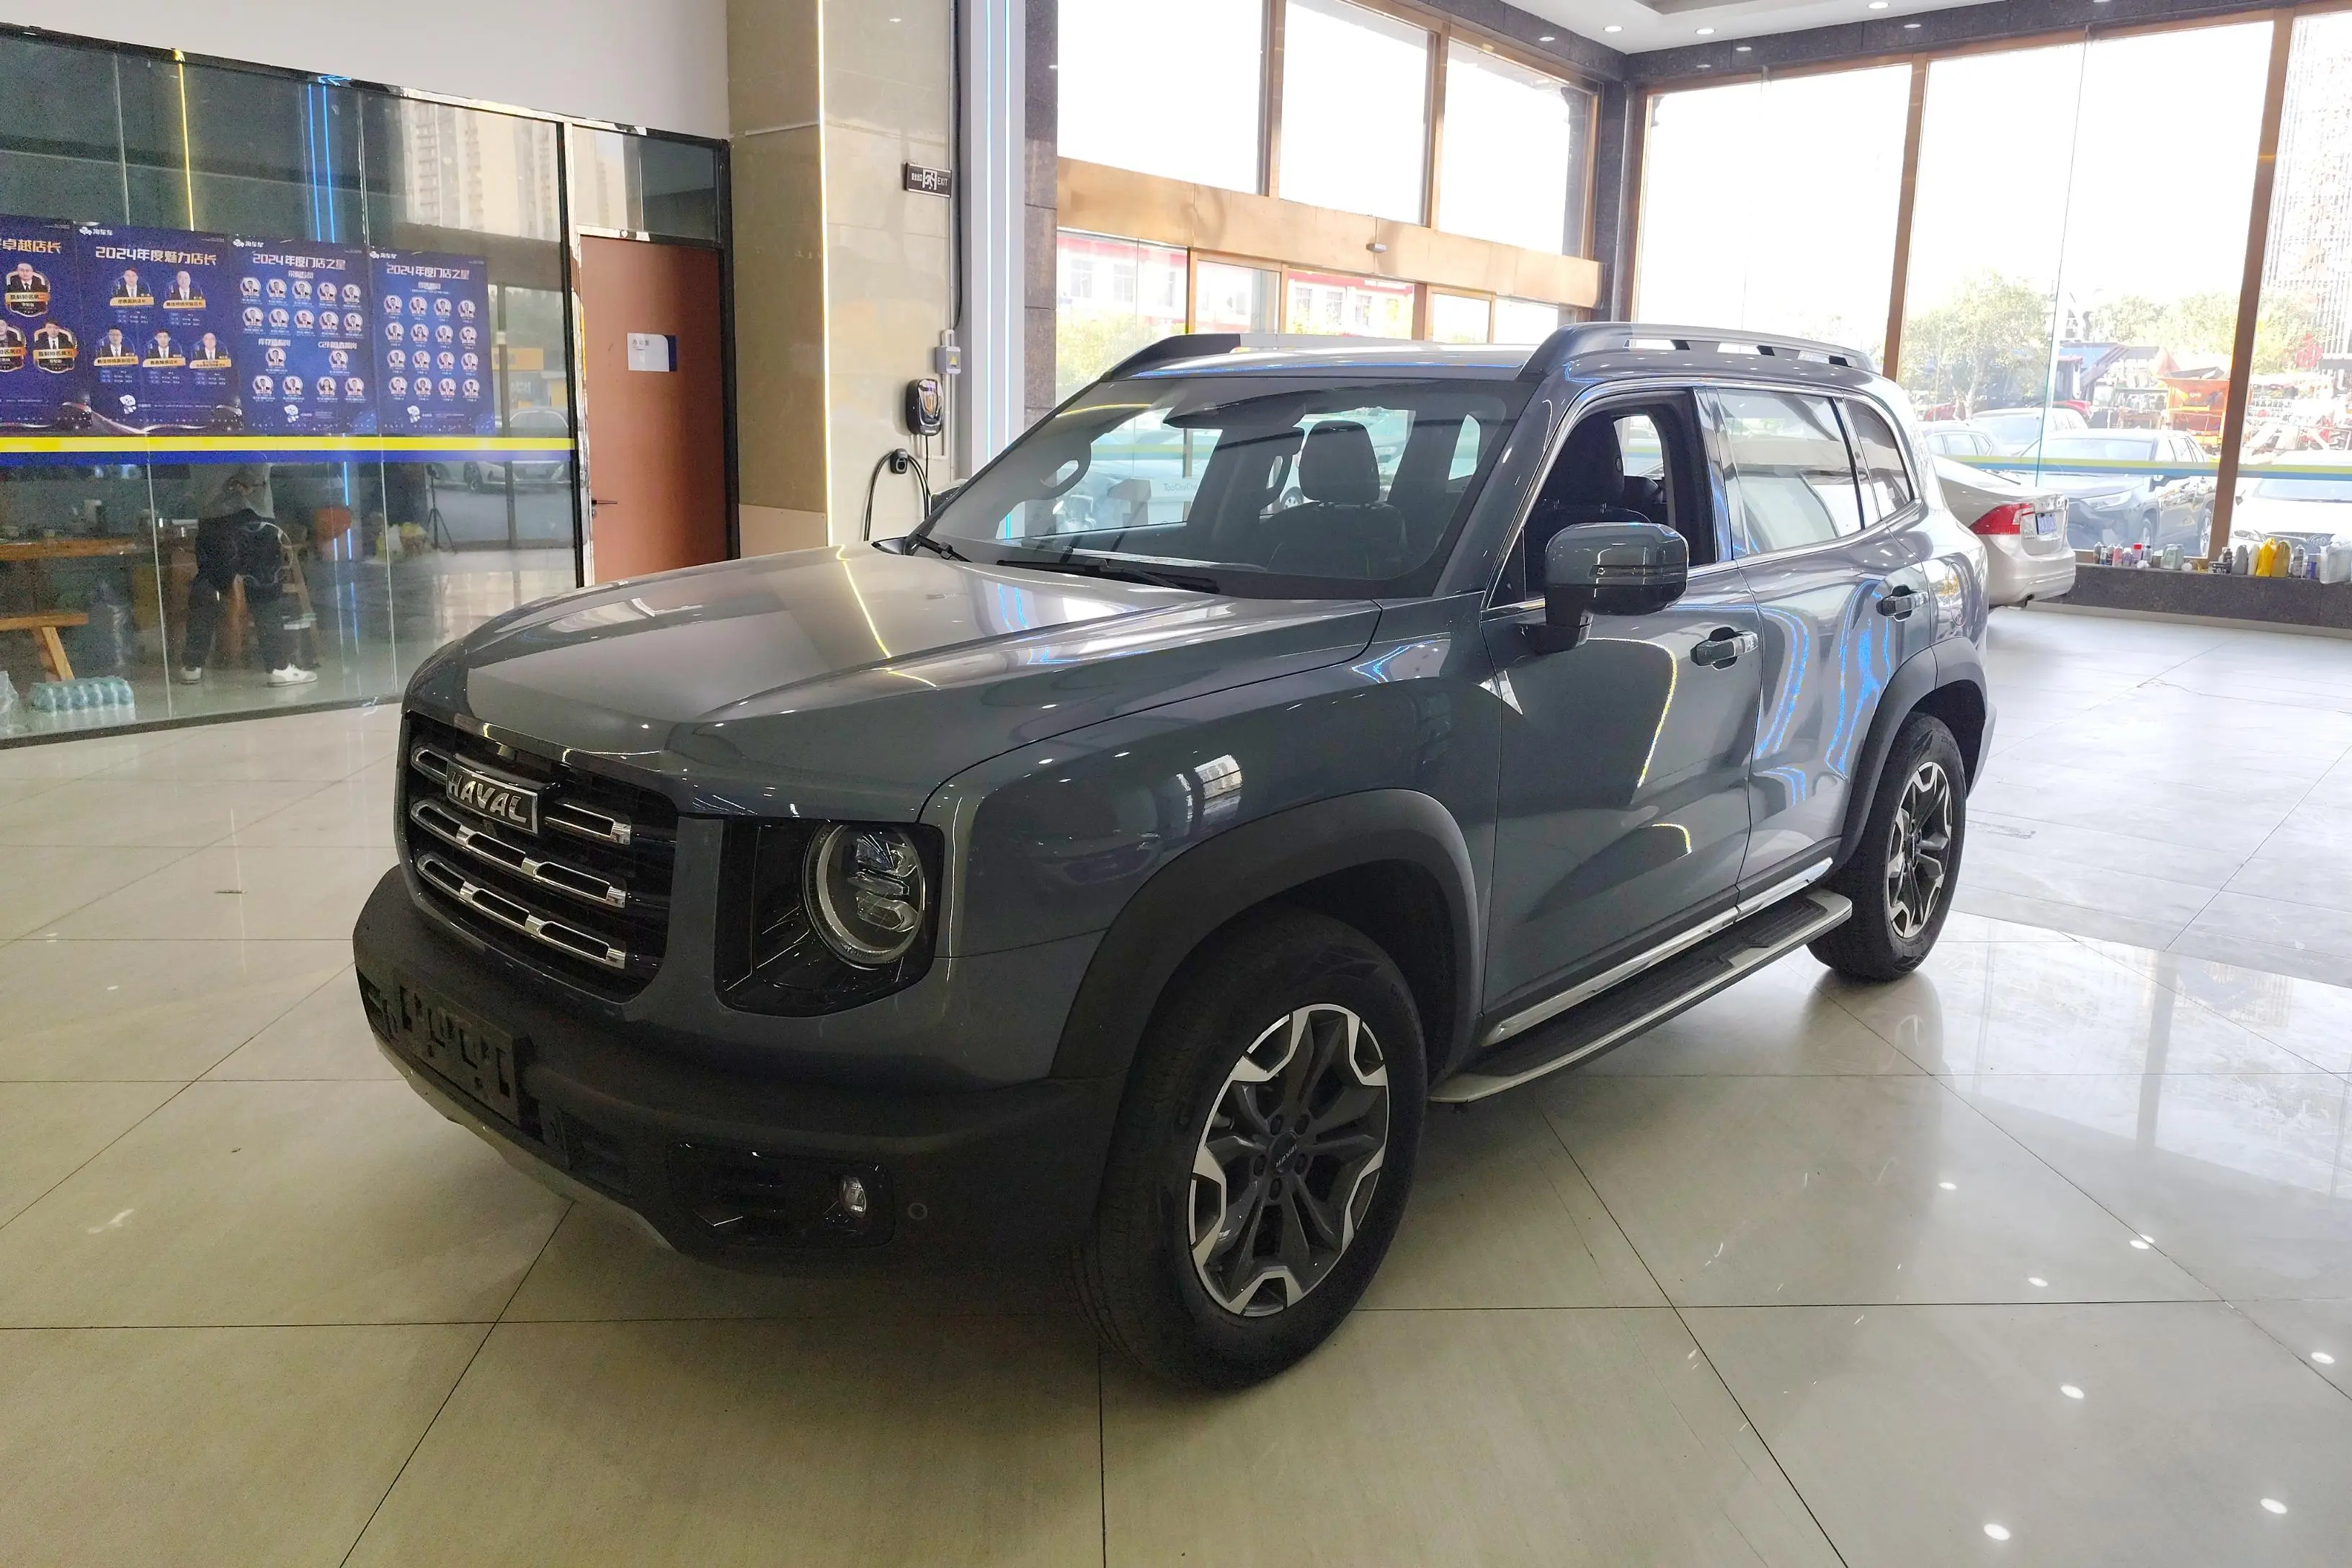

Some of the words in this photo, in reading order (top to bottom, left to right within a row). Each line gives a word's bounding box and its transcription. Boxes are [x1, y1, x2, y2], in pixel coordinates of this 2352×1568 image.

[937, 177, 948, 186] EXIT
[0, 238, 62, 254] 卓越店长
[447, 772, 527, 824] HAVAL
[1275, 1143, 1298, 1167] HAVAL
